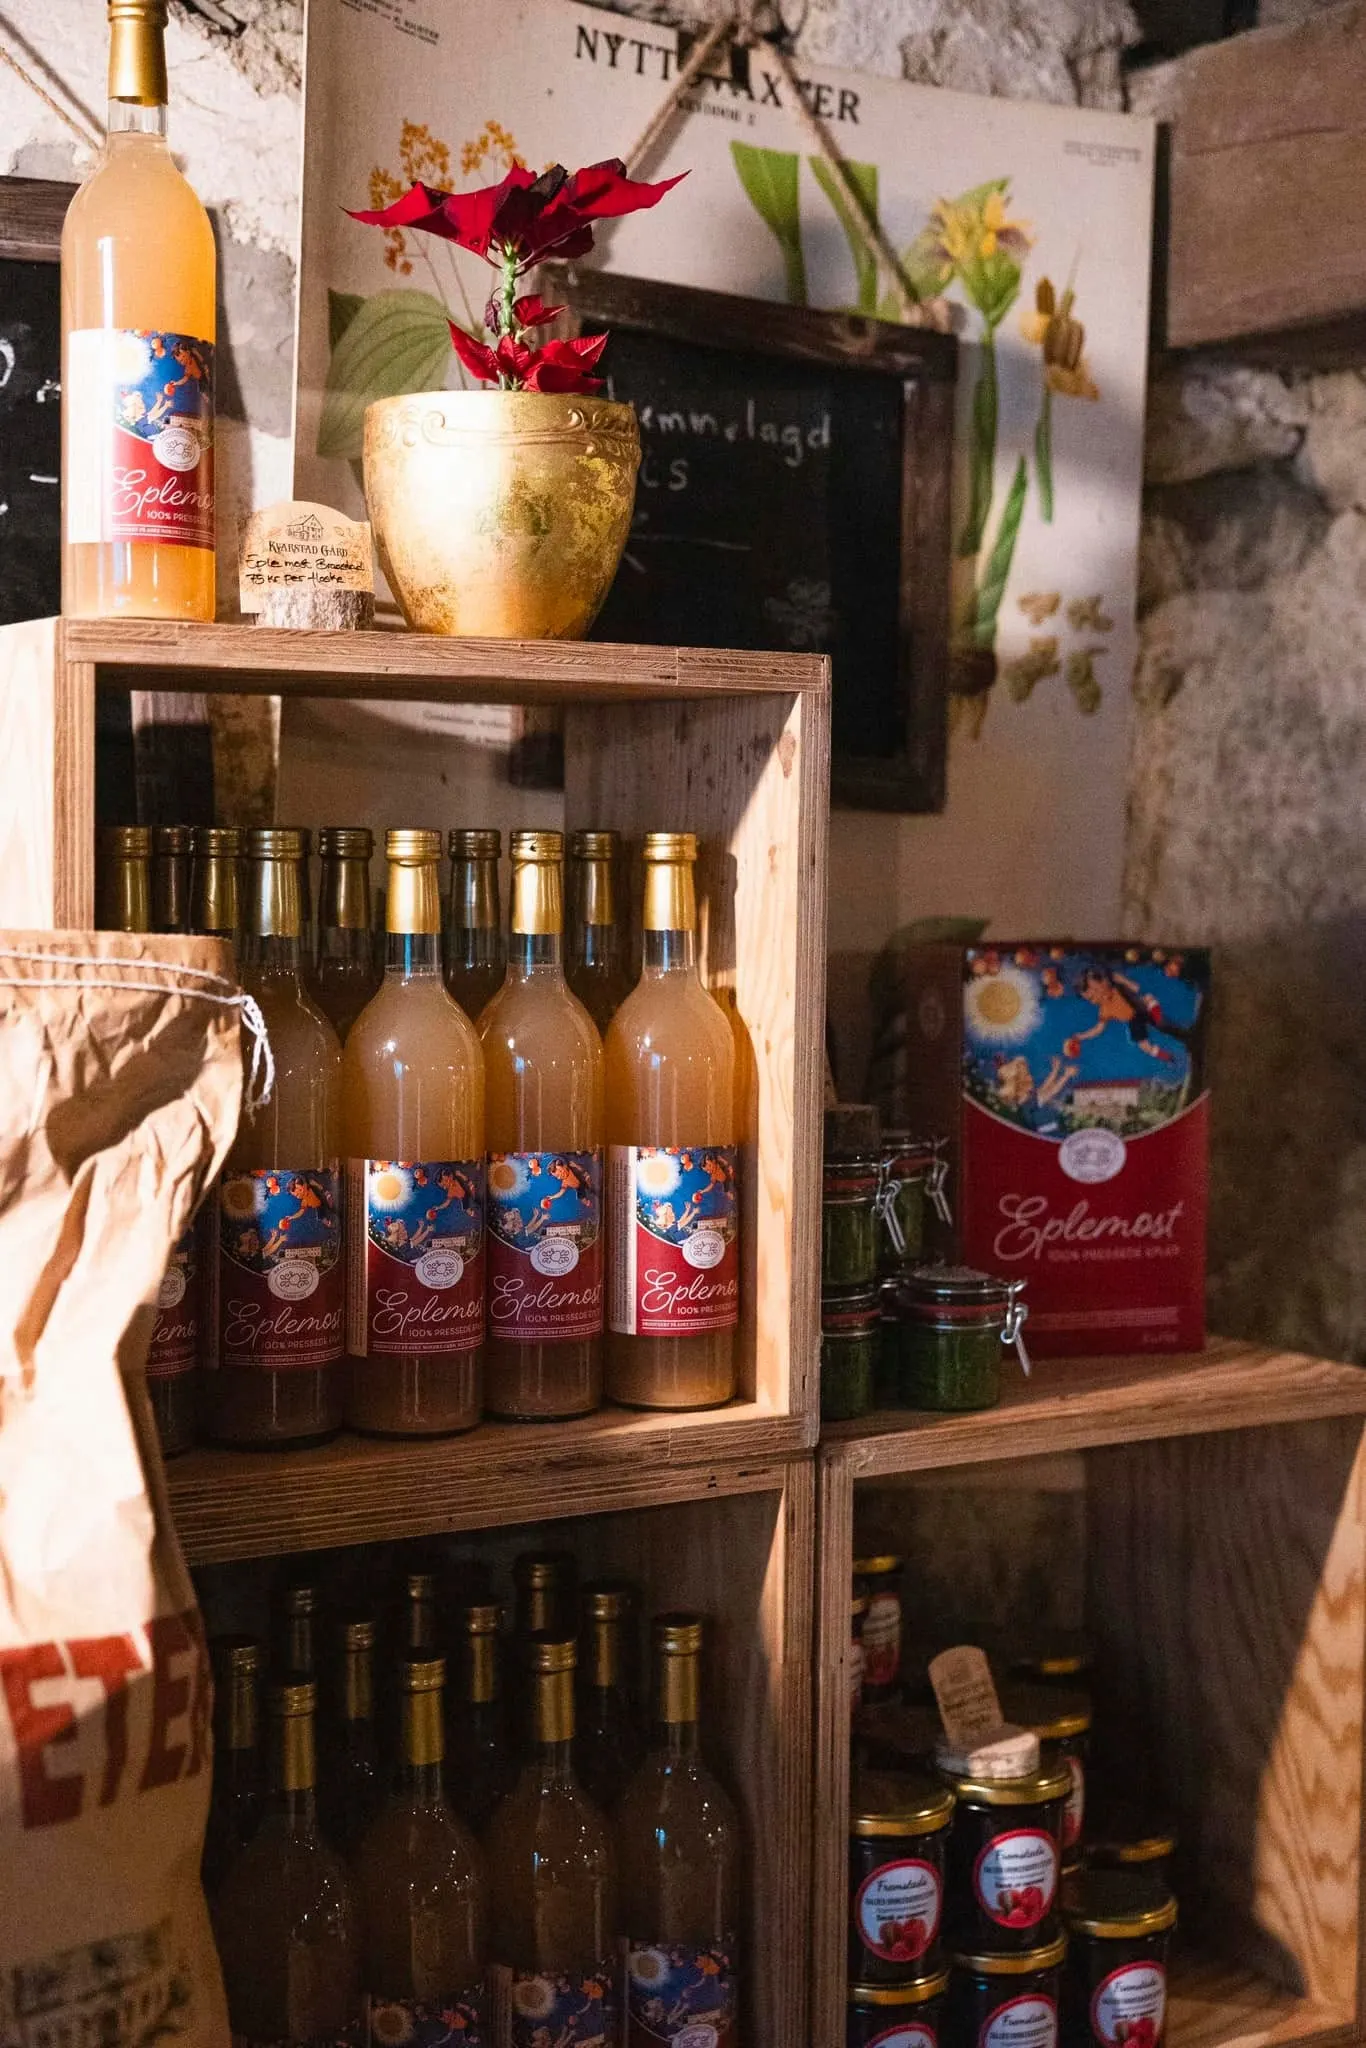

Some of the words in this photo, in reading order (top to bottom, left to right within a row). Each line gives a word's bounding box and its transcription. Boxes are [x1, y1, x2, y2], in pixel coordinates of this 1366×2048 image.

[245, 554, 283, 571] Eple
[994, 1193, 1185, 1261] Eplemost
[677, 1306, 699, 1315] 100%
[525, 1314, 548, 1322] 100%
[409, 1329, 432, 1337] 100%
